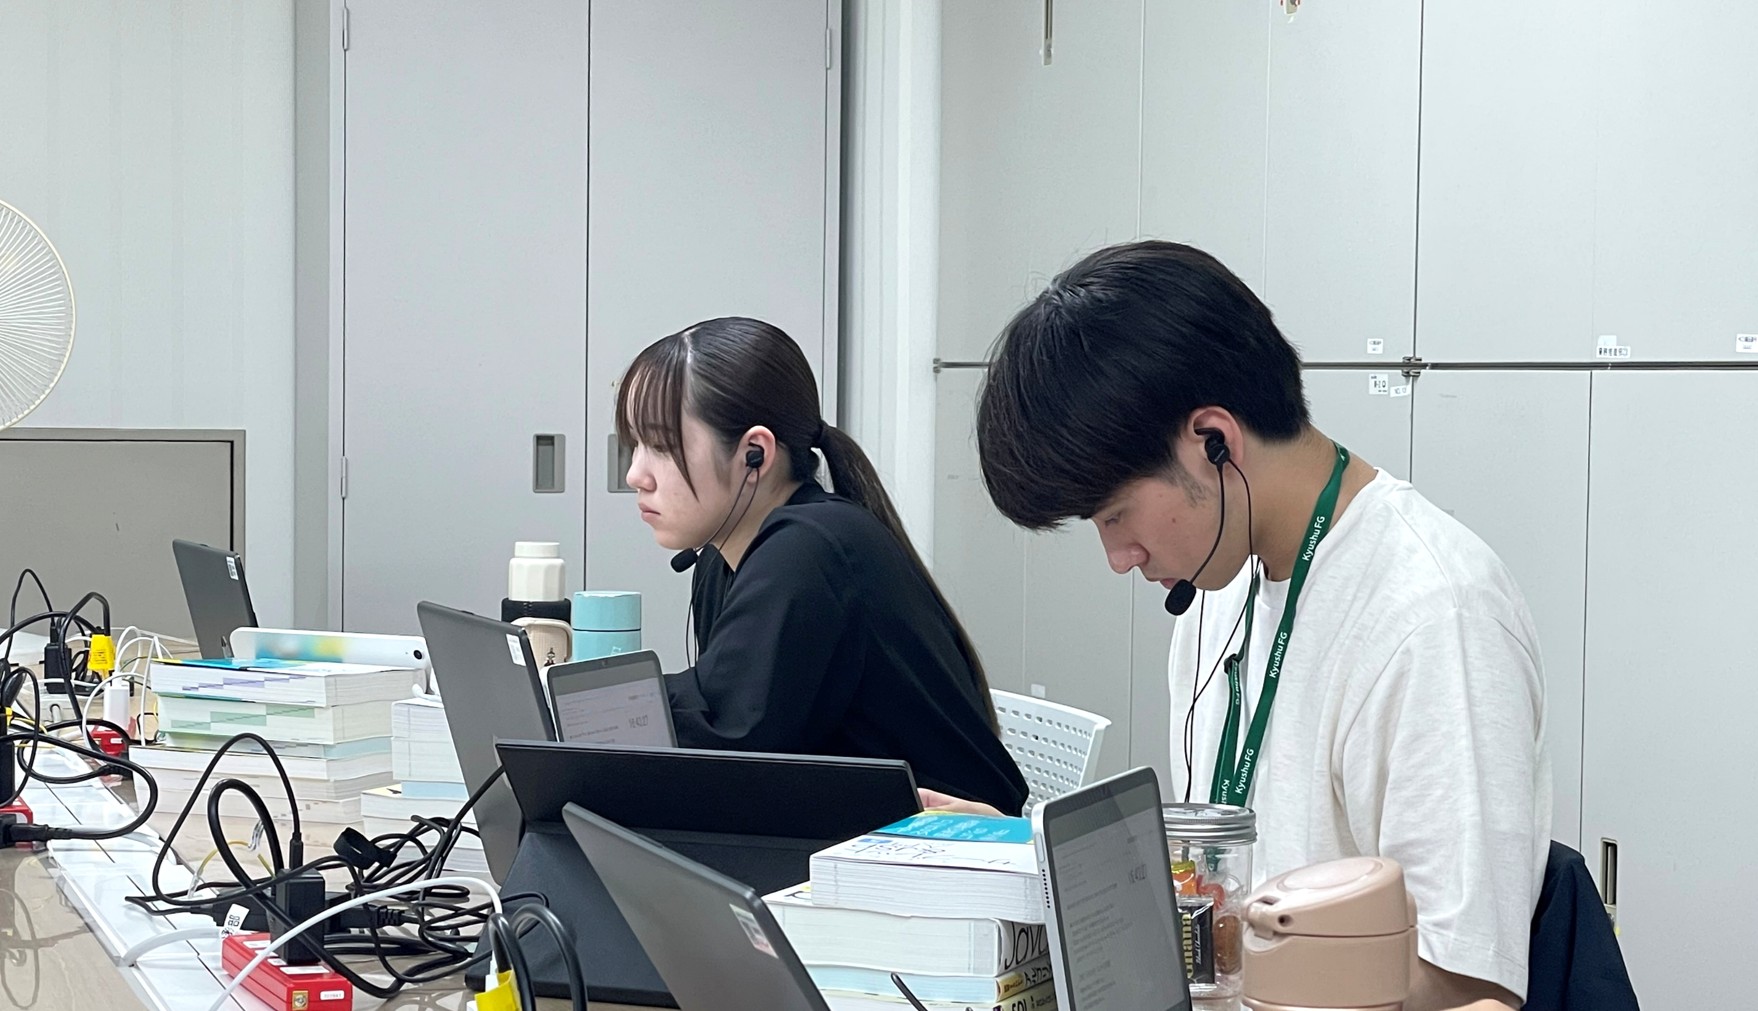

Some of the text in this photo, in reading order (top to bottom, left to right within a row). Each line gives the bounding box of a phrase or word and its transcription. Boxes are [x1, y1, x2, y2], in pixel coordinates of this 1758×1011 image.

[1301, 515, 1326, 561] Kyushu FG
[1269, 631, 1288, 679] Kyushu FG
[1234, 747, 1255, 795] Kyushu FG
